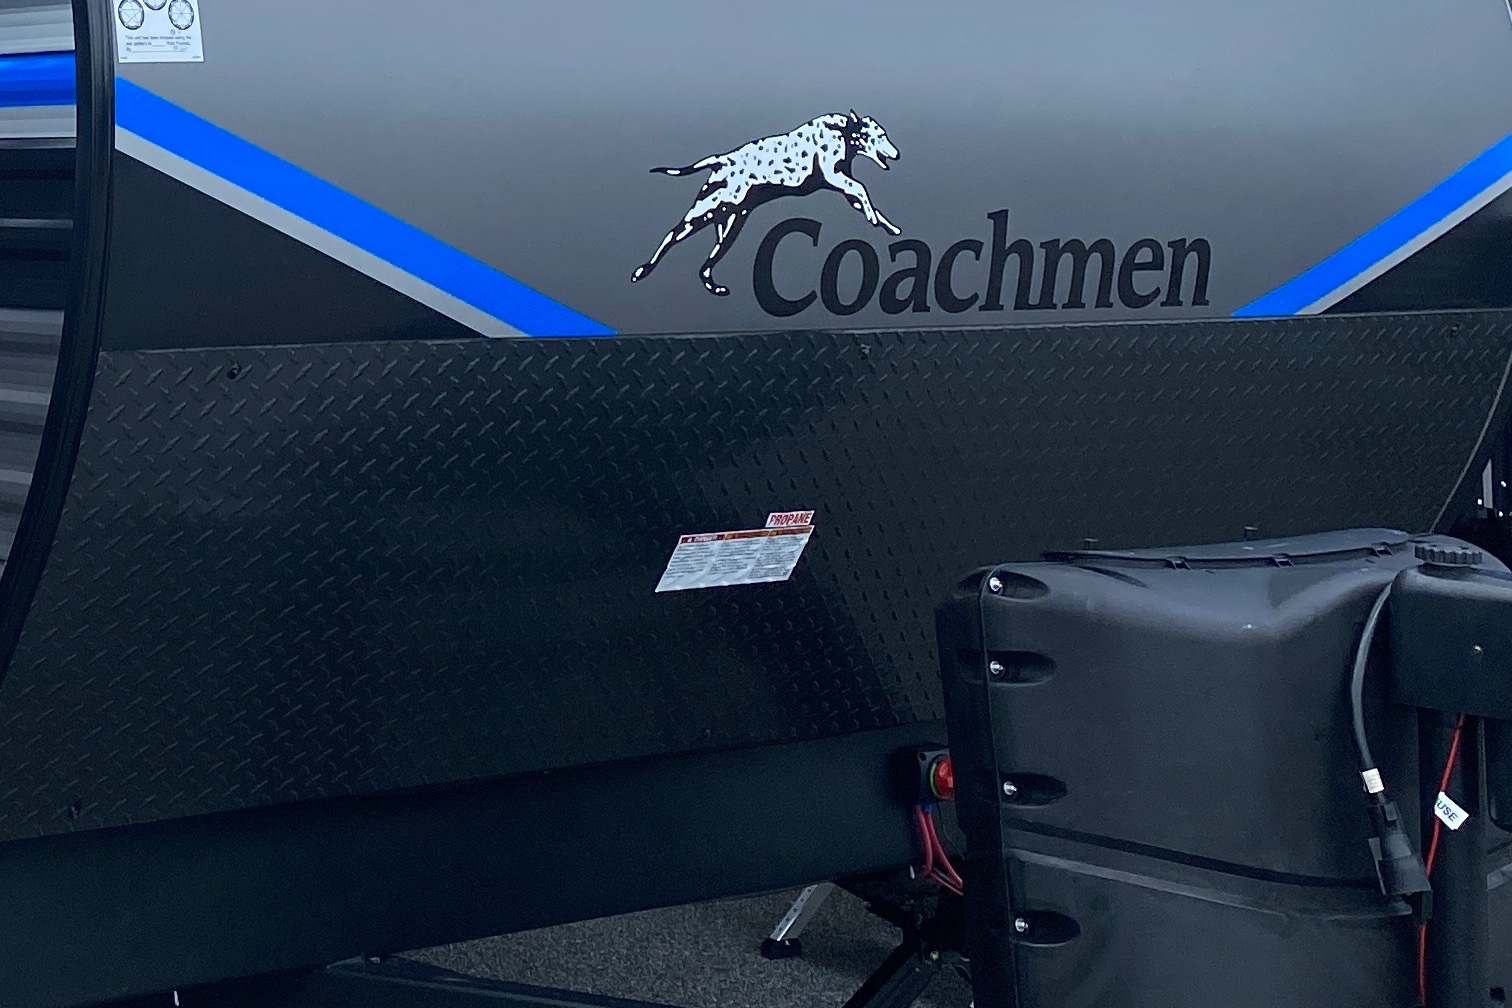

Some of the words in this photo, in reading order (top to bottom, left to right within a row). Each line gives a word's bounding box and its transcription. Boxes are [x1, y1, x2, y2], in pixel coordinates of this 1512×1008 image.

[752, 209, 1212, 318] Coachmen
[769, 512, 813, 526] PROPANE
[1436, 799, 1459, 823] USE
